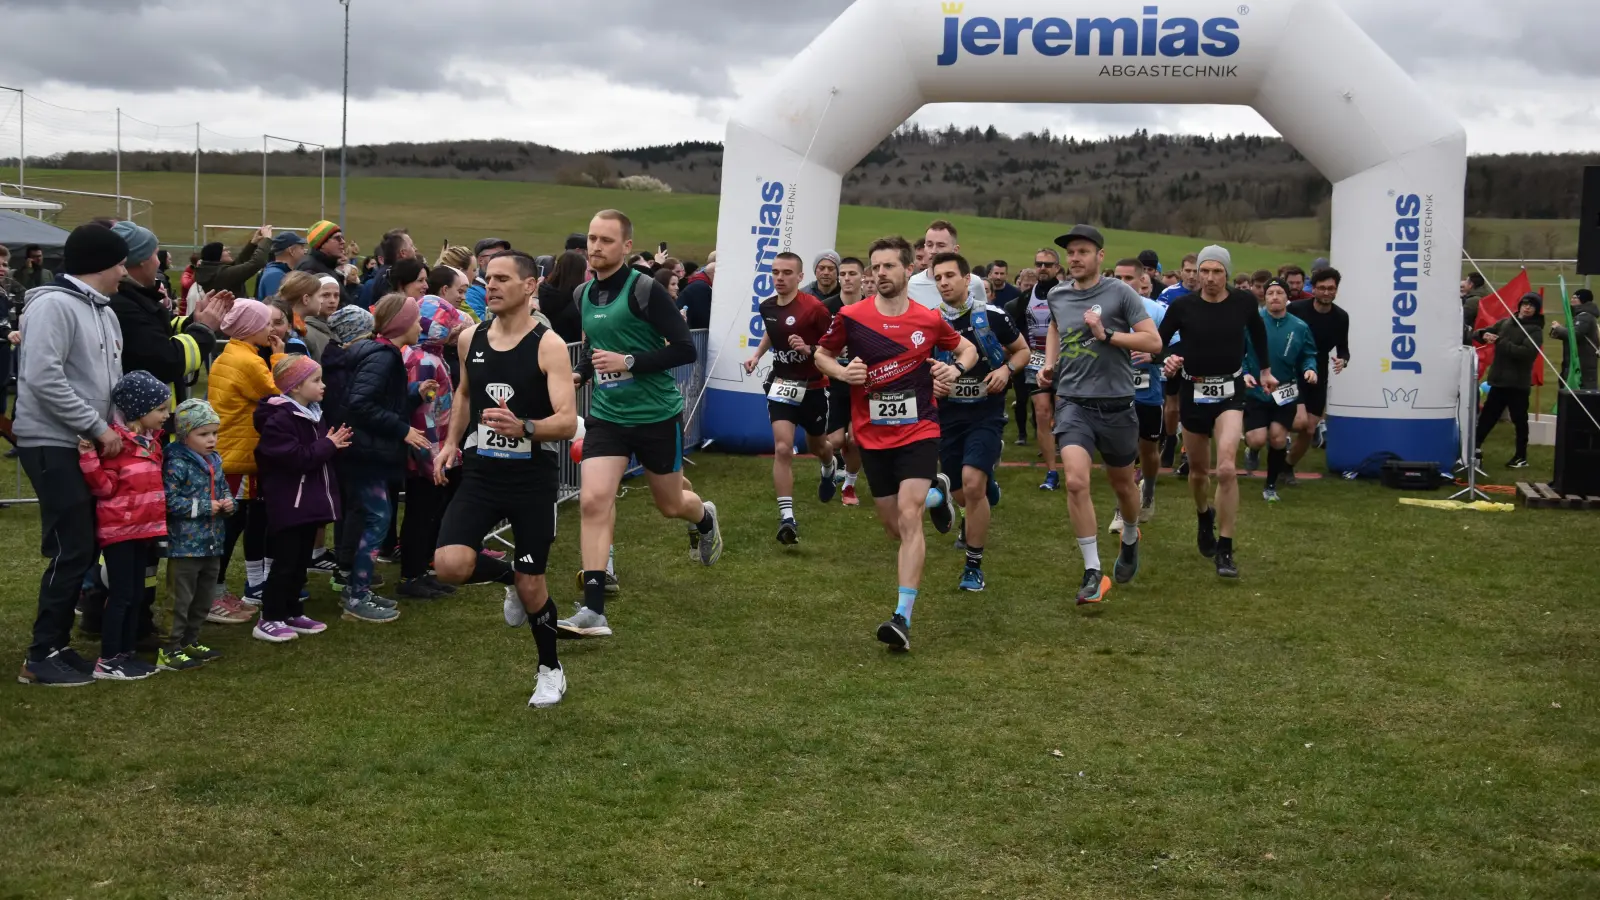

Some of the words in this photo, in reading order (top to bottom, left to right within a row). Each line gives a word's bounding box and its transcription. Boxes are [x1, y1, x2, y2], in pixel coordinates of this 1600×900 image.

[937, 5, 1240, 66] jeremias
[1099, 65, 1238, 77] ABGASTECHNIK
[783, 183, 797, 253] BGASTECHNIK
[1423, 194, 1433, 276] ABGASTECHNIK
[1386, 193, 1422, 374] jeremias
[868, 369, 878, 379] TV
[879, 361, 899, 374] 1860
[776, 386, 798, 399] 250
[955, 385, 980, 397] 206
[1202, 385, 1225, 396] 281
[1279, 387, 1295, 399] 220
[878, 402, 908, 417] 234
